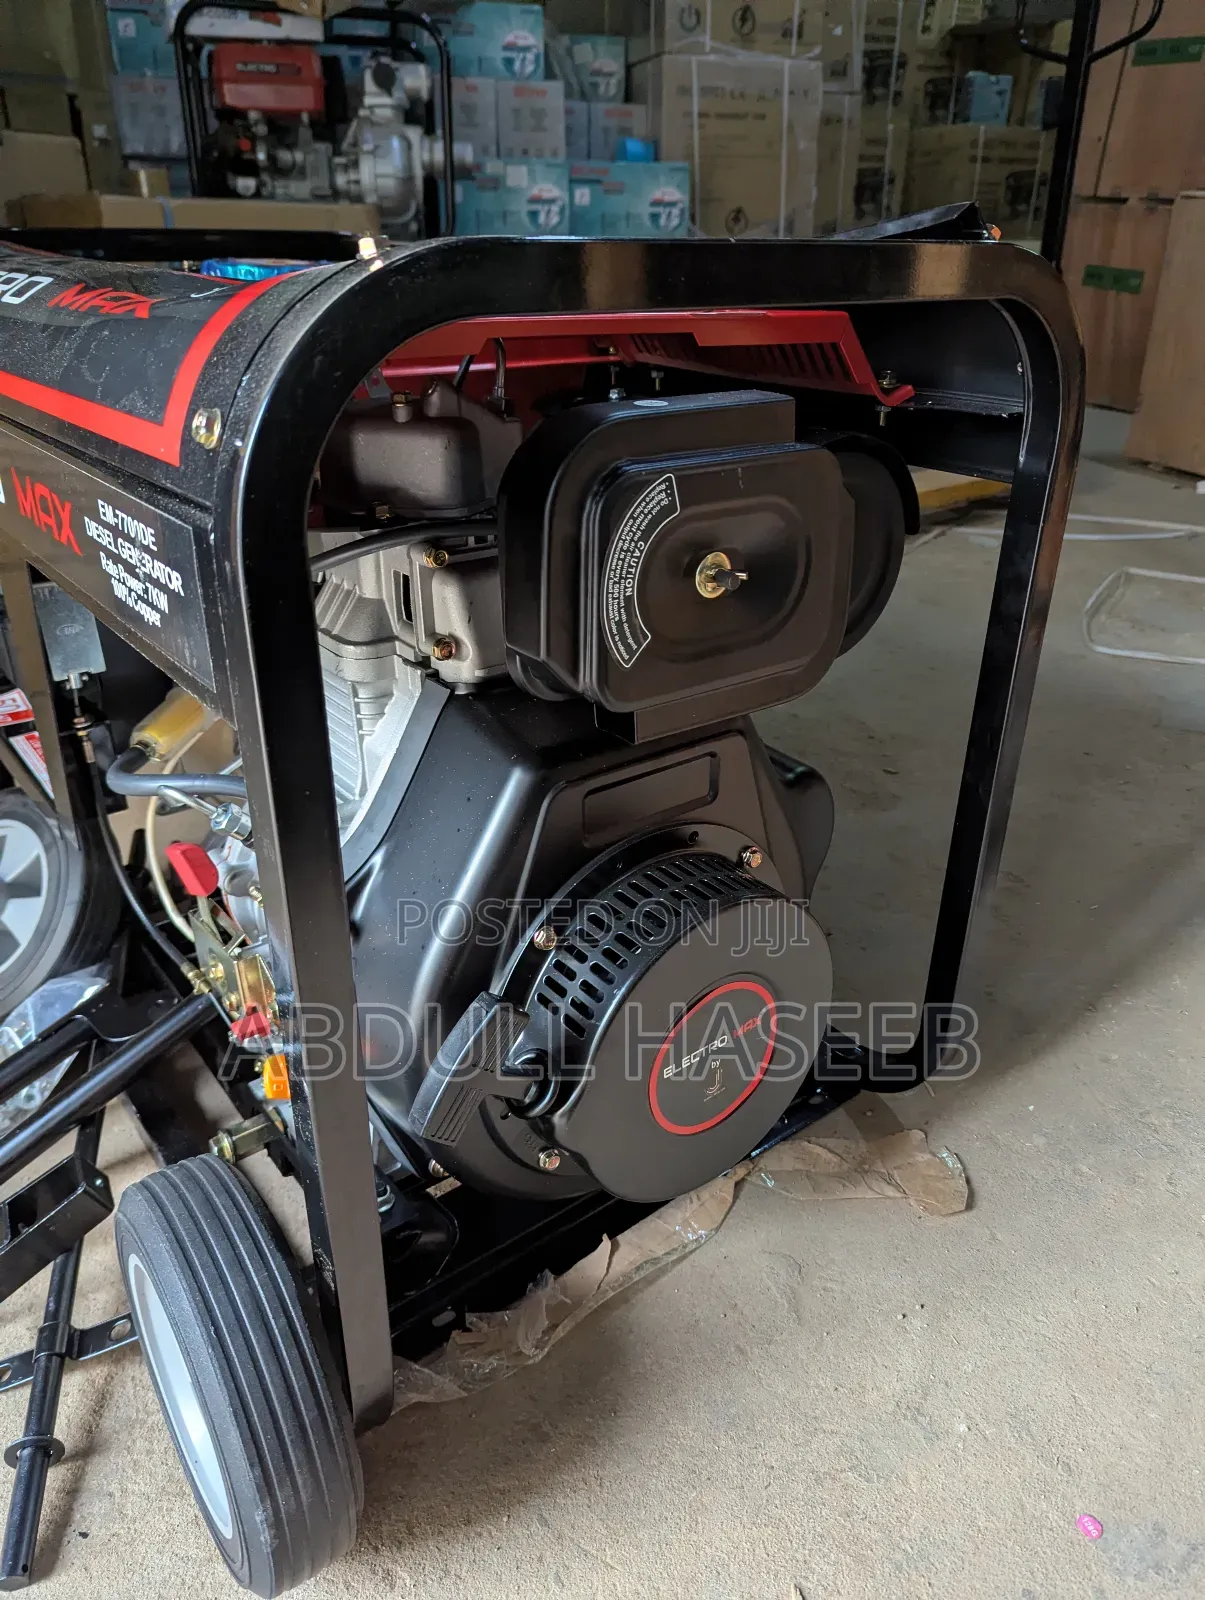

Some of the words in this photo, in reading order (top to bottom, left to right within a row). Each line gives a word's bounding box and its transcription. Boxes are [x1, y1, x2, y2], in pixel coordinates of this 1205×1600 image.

[47, 282, 167, 319] MAX
[10, 466, 83, 557] MAX
[633, 502, 646, 517] when
[640, 514, 652, 530] wash
[84, 515, 119, 554] DIESEL
[117, 537, 185, 597] GENERATOR
[613, 560, 622, 582] every
[622, 553, 631, 577] cleaner
[626, 542, 644, 596] CAUTION
[99, 551, 120, 579] Rate
[145, 581, 169, 614] 7KW
[663, 1035, 728, 1079] ELECTRO
[733, 1017, 762, 1039] MAX
[711, 1059, 721, 1069] by
